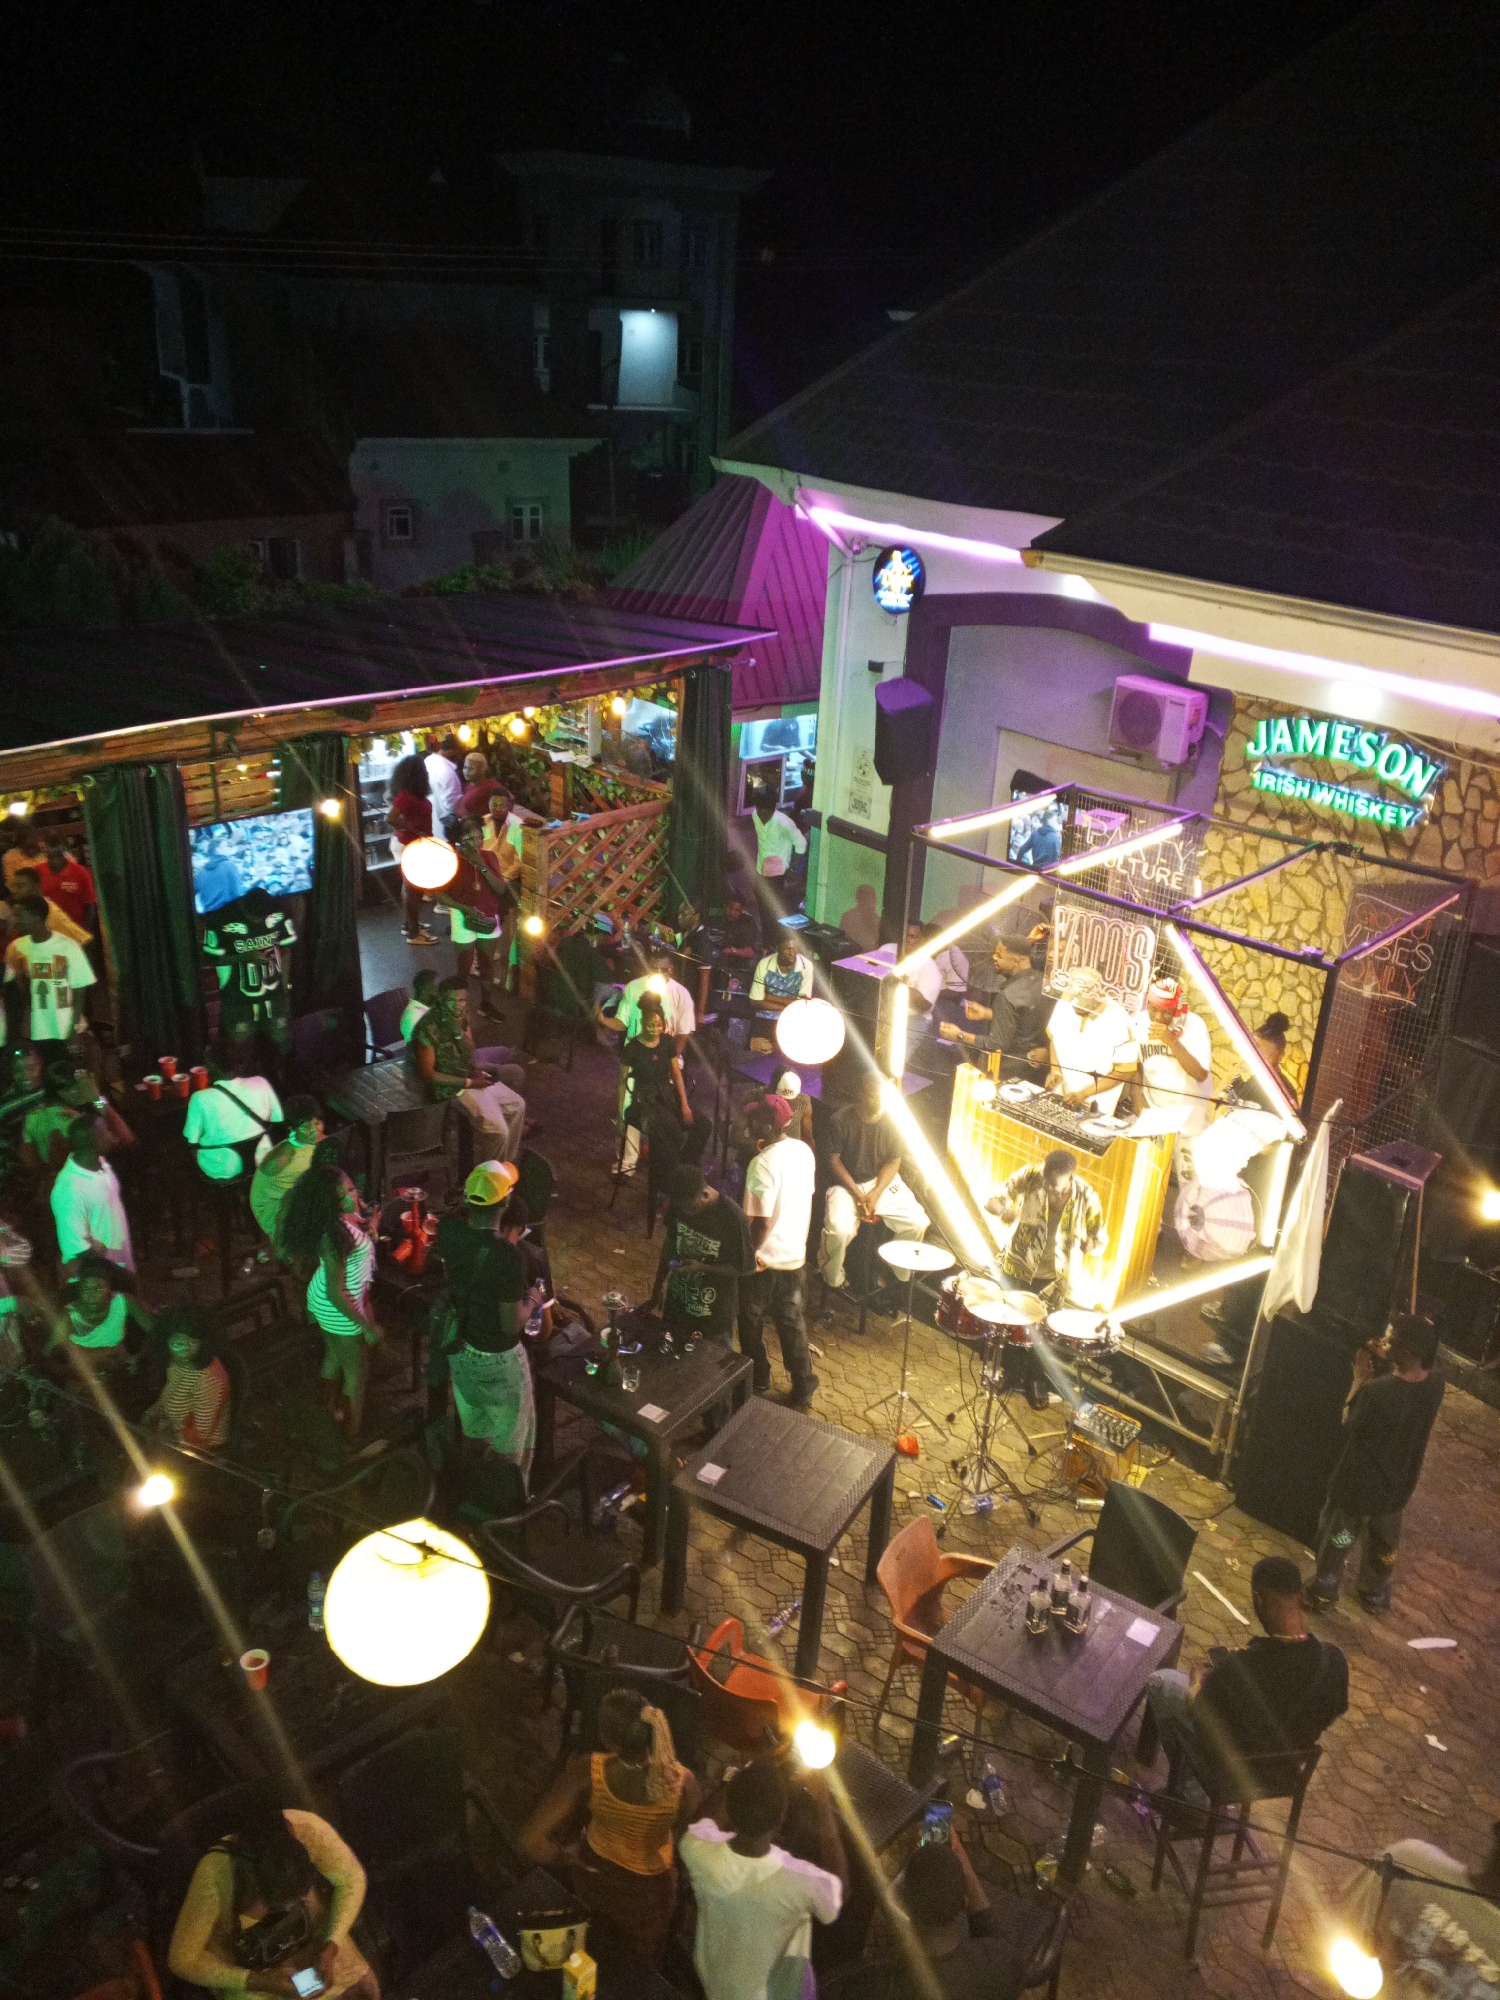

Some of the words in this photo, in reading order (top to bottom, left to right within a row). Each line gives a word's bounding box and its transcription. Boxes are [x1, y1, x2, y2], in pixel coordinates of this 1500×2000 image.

[1246, 716, 1438, 799] JAMESON
[1253, 770, 1311, 799] IRISH
[1312, 783, 1416, 829] WHISKEY
[1090, 846, 1185, 891] ULTURE
[1139, 1042, 1174, 1063] MONCL
